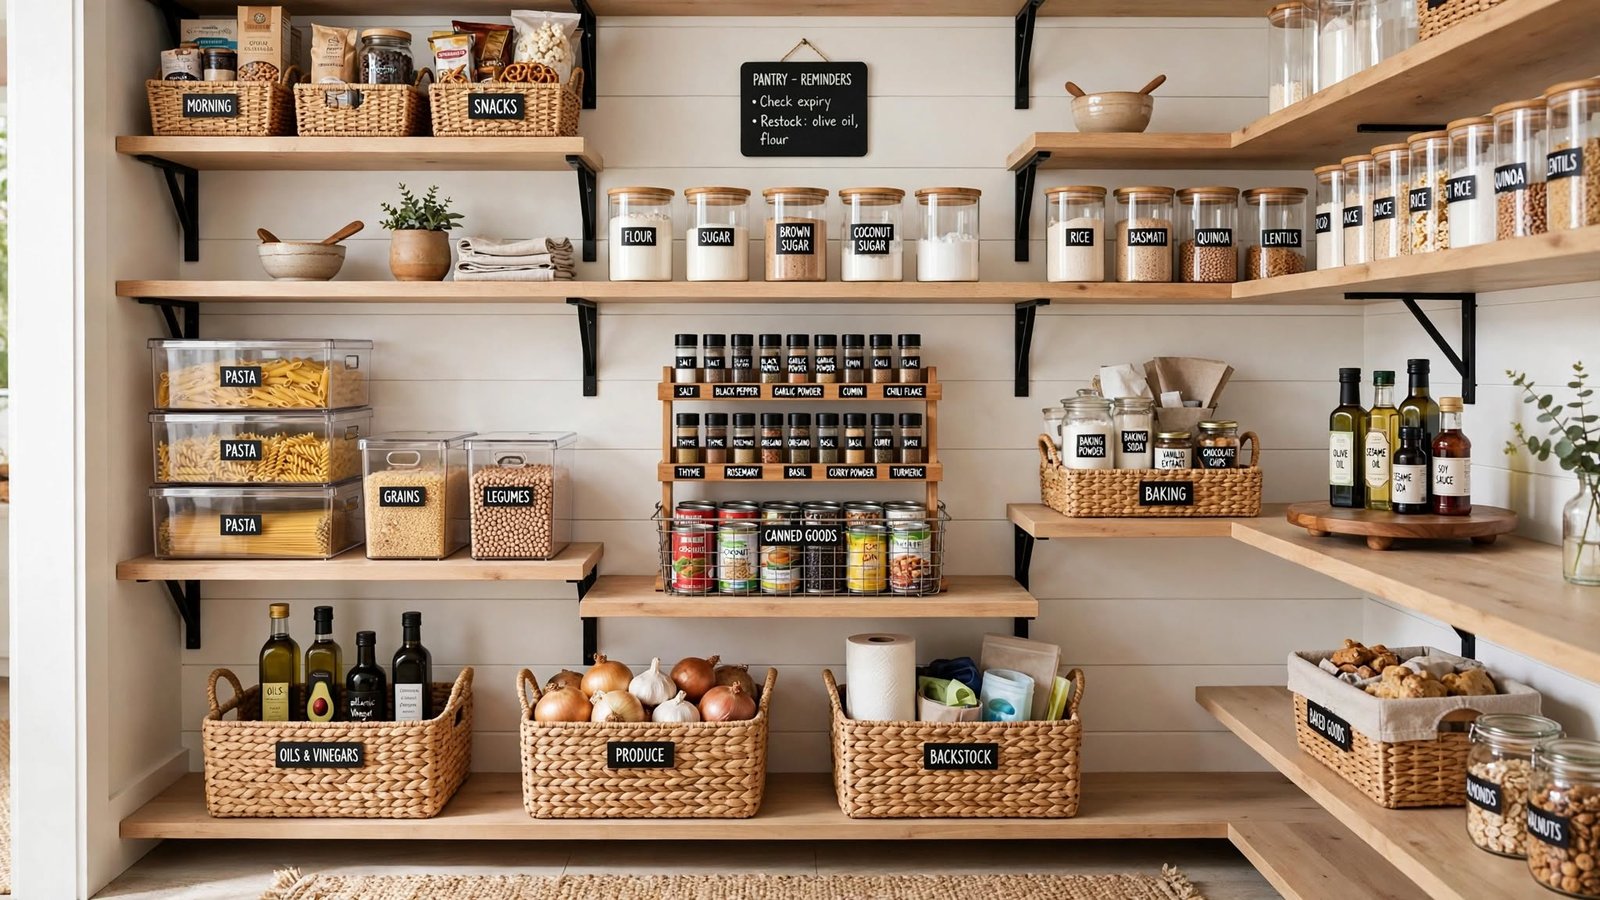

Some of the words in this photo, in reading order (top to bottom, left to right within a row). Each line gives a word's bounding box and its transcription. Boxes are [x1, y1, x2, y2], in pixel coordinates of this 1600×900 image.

[753, 73, 788, 86] PANTRY
[800, 73, 852, 86] REMINDERS
[187, 99, 232, 113] MORNING
[474, 99, 518, 115] SNACKS
[759, 95, 793, 107] Check
[797, 96, 832, 111] expiry
[760, 114, 807, 127] Restock:
[812, 115, 837, 126] olive
[841, 114, 859, 128] oil,
[760, 132, 789, 146] flour
[1454, 180, 1472, 197] RICE
[1410, 192, 1427, 208] RICE
[624, 230, 653, 243] FLOUR
[701, 231, 731, 243] SUGAR
[779, 226, 811, 238] BROWN
[853, 227, 892, 238] COCONUT
[1070, 231, 1091, 244] RICE
[1130, 232, 1165, 244] BASMATI
[1197, 231, 1231, 246] QUINOA
[1264, 233, 1299, 245] LENTILS
[781, 239, 810, 251] SUGAR
[858, 239, 886, 251] SUGAR
[225, 370, 256, 384] PASTA
[679, 387, 694, 396] SALT
[715, 387, 734, 396] BLACK
[736, 386, 759, 396] PEPPER
[774, 387, 796, 396] GARLIC
[797, 387, 822, 396] POWDER
[842, 387, 863, 396] CUMIN
[904, 387, 923, 396] FLAKE
[1079, 436, 1103, 446] BAKING
[1124, 432, 1147, 442] BAKING
[225, 444, 256, 457] PASTA
[1078, 446, 1104, 456] POWDER
[1127, 443, 1144, 452] SODA
[1202, 448, 1235, 457] CHOCOLATE
[1333, 449, 1348, 458] OLIVE
[1366, 447, 1387, 458] SESAME
[1336, 460, 1345, 469] OIL
[1372, 459, 1381, 469] OIL
[1437, 464, 1449, 474] SOY
[678, 468, 700, 477] THYME
[726, 468, 760, 477] ROSEMARY
[788, 468, 807, 477] BASIL
[829, 468, 849, 477] CURRY
[850, 468, 875, 477] POWDER
[893, 468, 923, 477] TURMERIC
[1435, 475, 1454, 485] SAUCE
[384, 490, 420, 503] GRAINS
[487, 490, 530, 503] LEGUMES
[1145, 487, 1187, 501] BAKING
[225, 519, 256, 532] PASTA
[764, 529, 803, 542] CANNED
[805, 529, 837, 542] GOODS
[266, 686, 284, 696] OILS
[1309, 707, 1326, 731] BAKED
[1326, 719, 1345, 744] GOODS
[280, 748, 300, 763] OILS
[303, 750, 311, 761] &
[313, 748, 359, 763] VINEGARS
[615, 747, 665, 763] PRODUCE
[930, 749, 992, 765] BACKSTOCK
